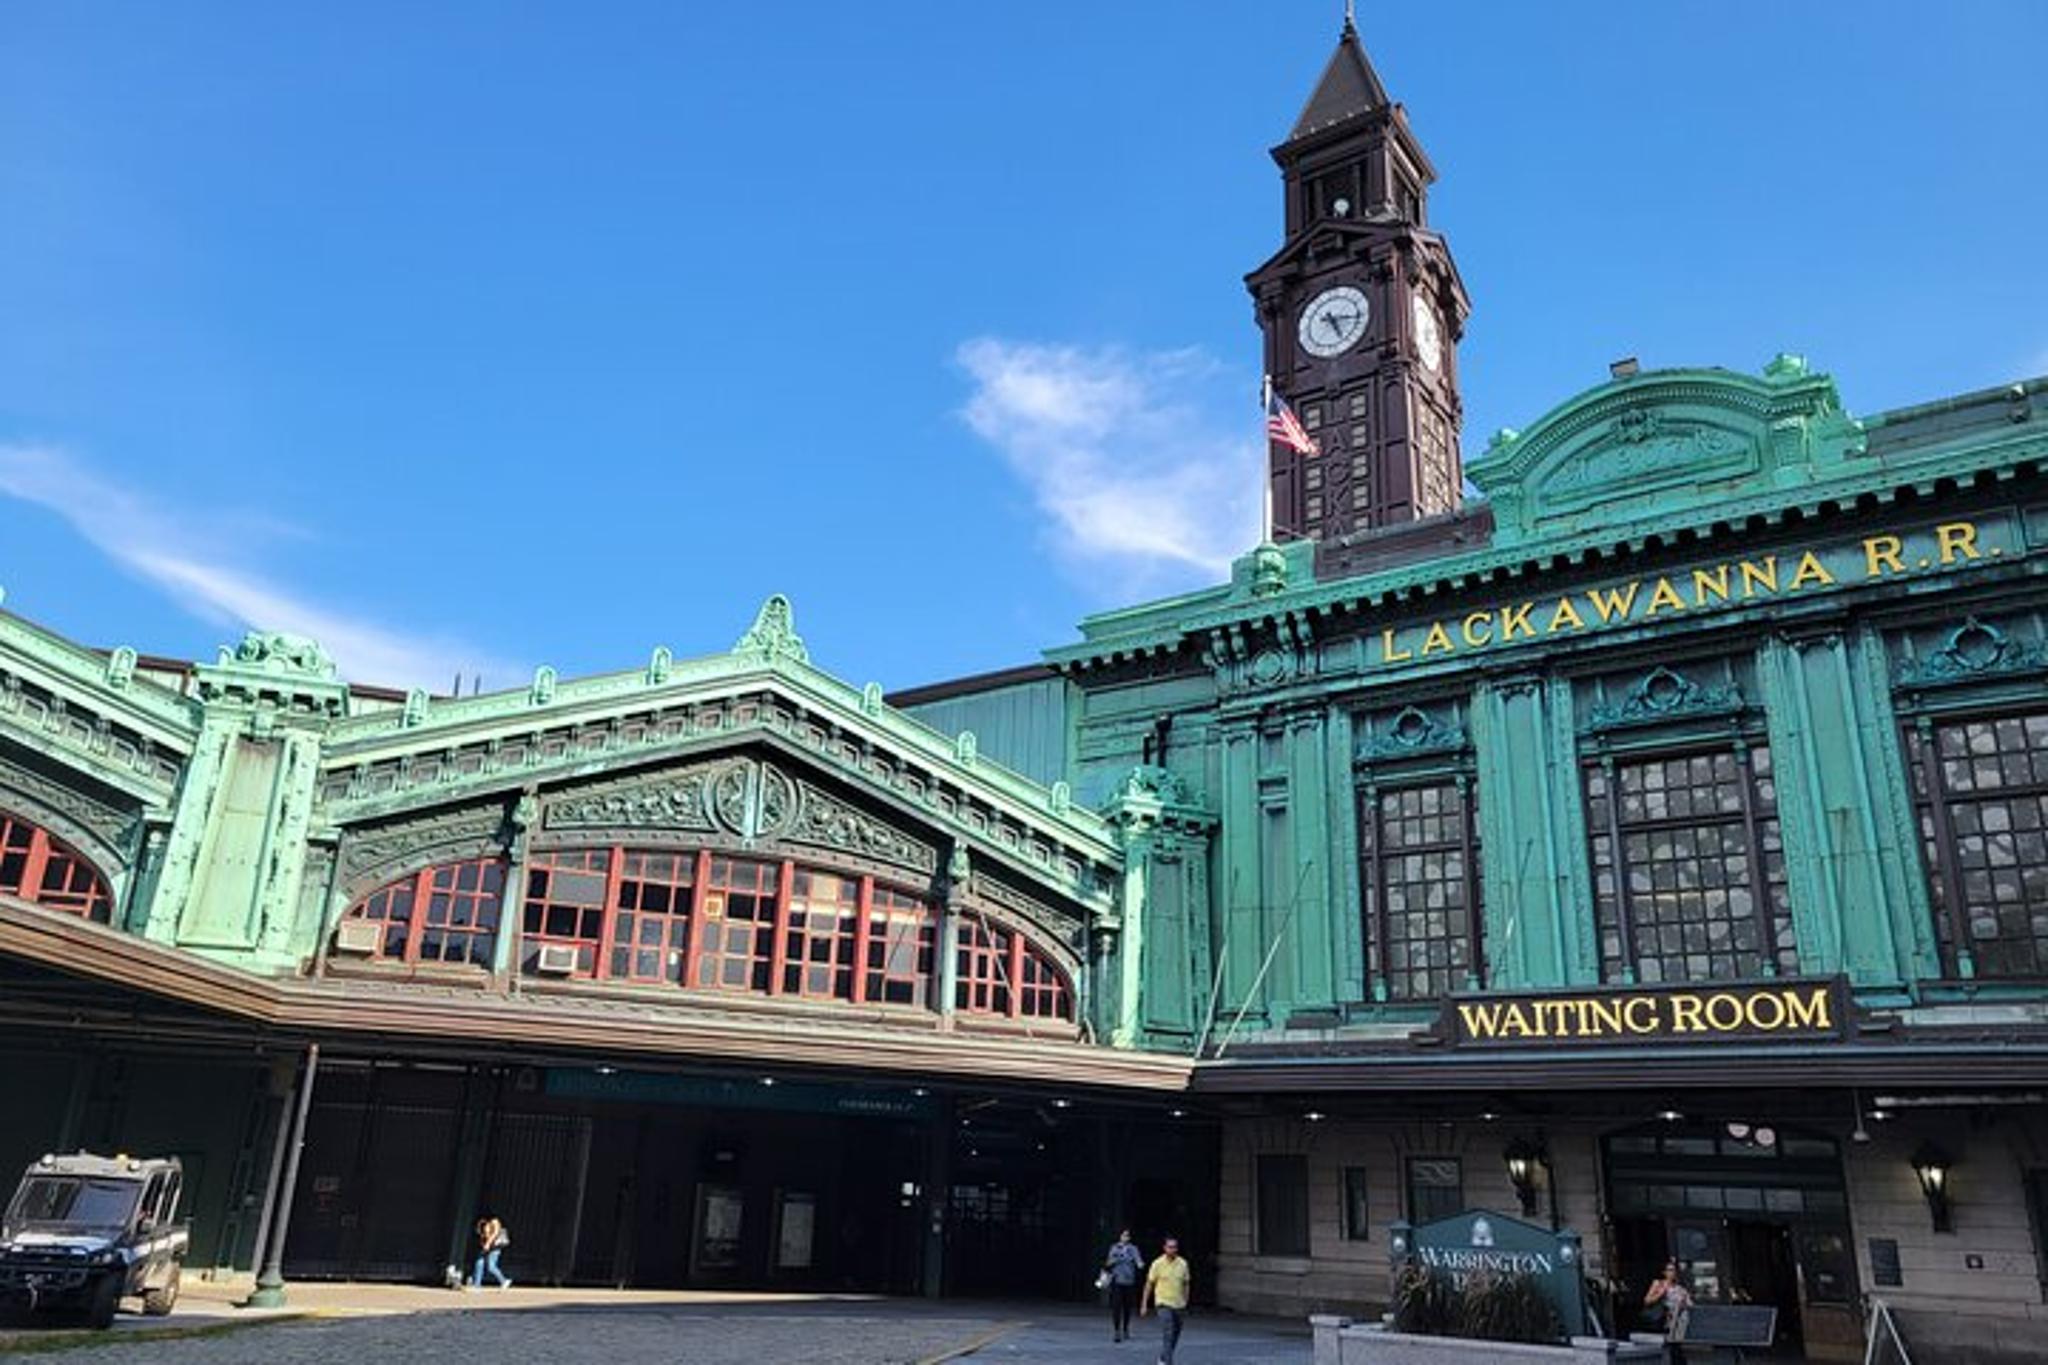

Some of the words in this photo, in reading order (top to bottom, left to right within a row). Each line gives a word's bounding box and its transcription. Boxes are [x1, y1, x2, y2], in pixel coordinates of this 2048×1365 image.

[1383, 551, 1835, 662] LACKAWANNA
[1458, 999, 1660, 1038] WAITING
[1672, 989, 1830, 1032] ROOM
[1419, 1247, 1552, 1273] WARRINGTON
